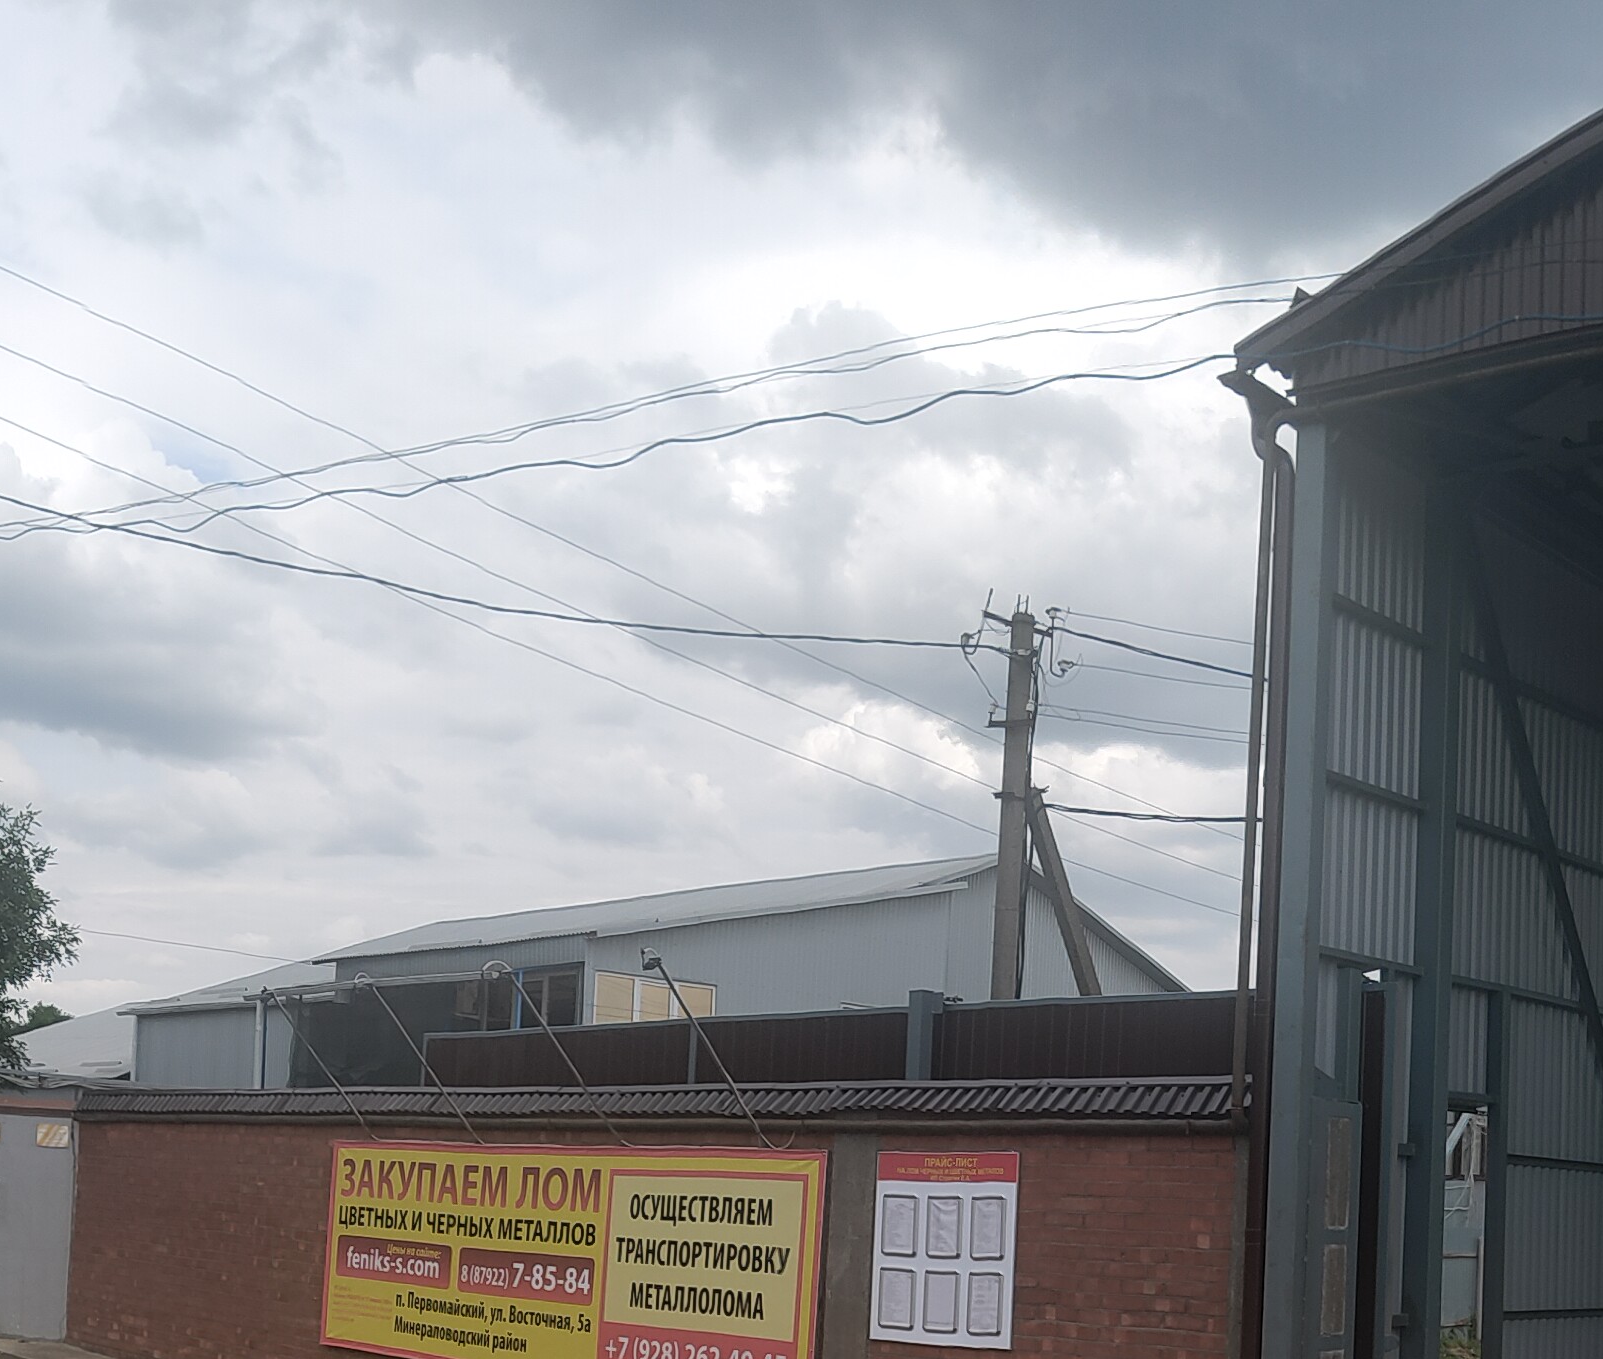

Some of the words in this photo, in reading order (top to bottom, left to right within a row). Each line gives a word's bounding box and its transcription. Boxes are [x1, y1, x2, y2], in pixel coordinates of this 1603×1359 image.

[924, 1156, 978, 1168] ПРАЙС-ЛИСТ
[340, 1158, 508, 1209] ЗАКУПАЕМ
[515, 1166, 602, 1213] ЛОМ
[338, 1205, 407, 1231] ЦВЕТНЫХ
[411, 1210, 423, 1232] И
[426, 1212, 494, 1240] ЧЕРНЫХ
[497, 1218, 596, 1246] МЕТАЛЛОВ
[629, 1193, 773, 1227] ОСУЩЕСТВЛЯЕМ
[347, 1246, 439, 1279] feniks-s.com
[616, 1237, 791, 1275] ТРАНСПОРТИРОВКУ
[460, 1265, 468, 1282] 8
[469, 1264, 509, 1290] (87922)
[512, 1262, 590, 1295] 7-85-84
[396, 1294, 405, 1307] п.
[407, 1291, 488, 1324] Первомайский,
[490, 1308, 506, 1326] ул.
[509, 1305, 575, 1334] Восточная,
[577, 1314, 591, 1333] 5а
[629, 1282, 764, 1321] МЕТАЛЛОЛОМА
[394, 1314, 490, 1348] Минераловодский
[492, 1329, 527, 1353] район
